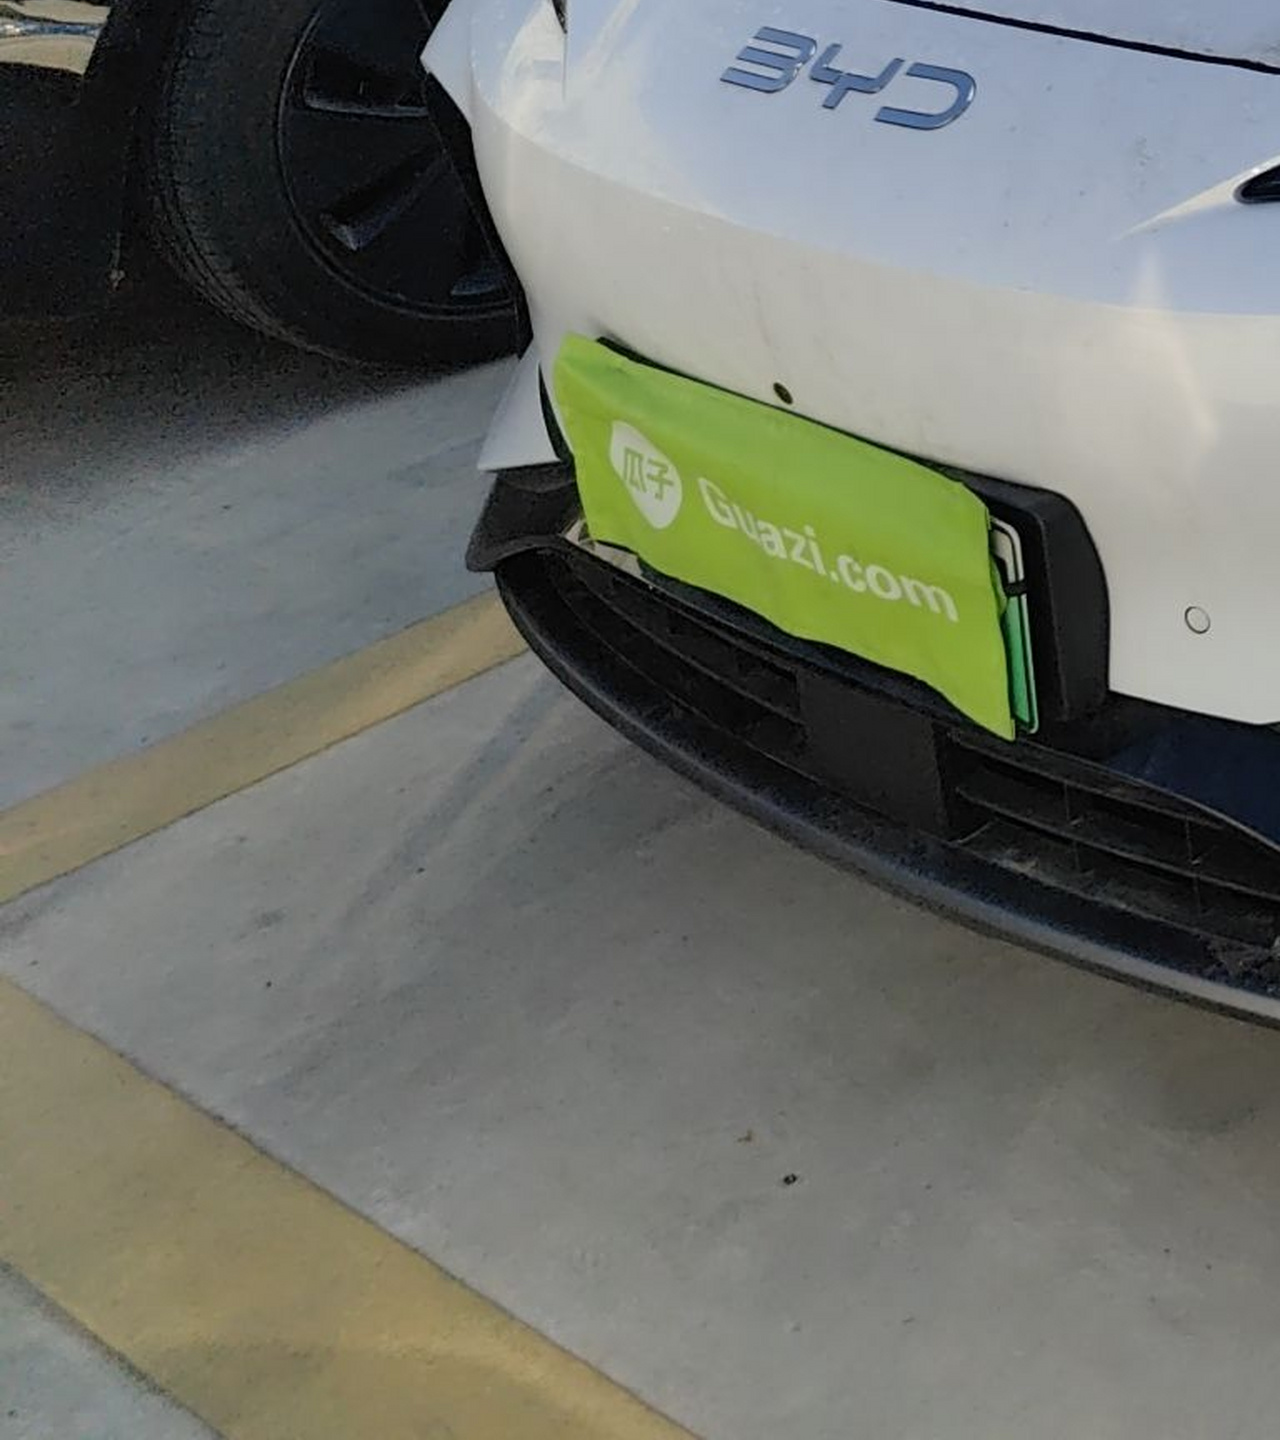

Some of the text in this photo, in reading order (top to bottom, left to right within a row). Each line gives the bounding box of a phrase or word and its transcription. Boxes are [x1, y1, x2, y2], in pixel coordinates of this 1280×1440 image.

[720, 26, 977, 130] BYD
[623, 446, 675, 502] 瓜子
[698, 475, 960, 624] Guazi.com
